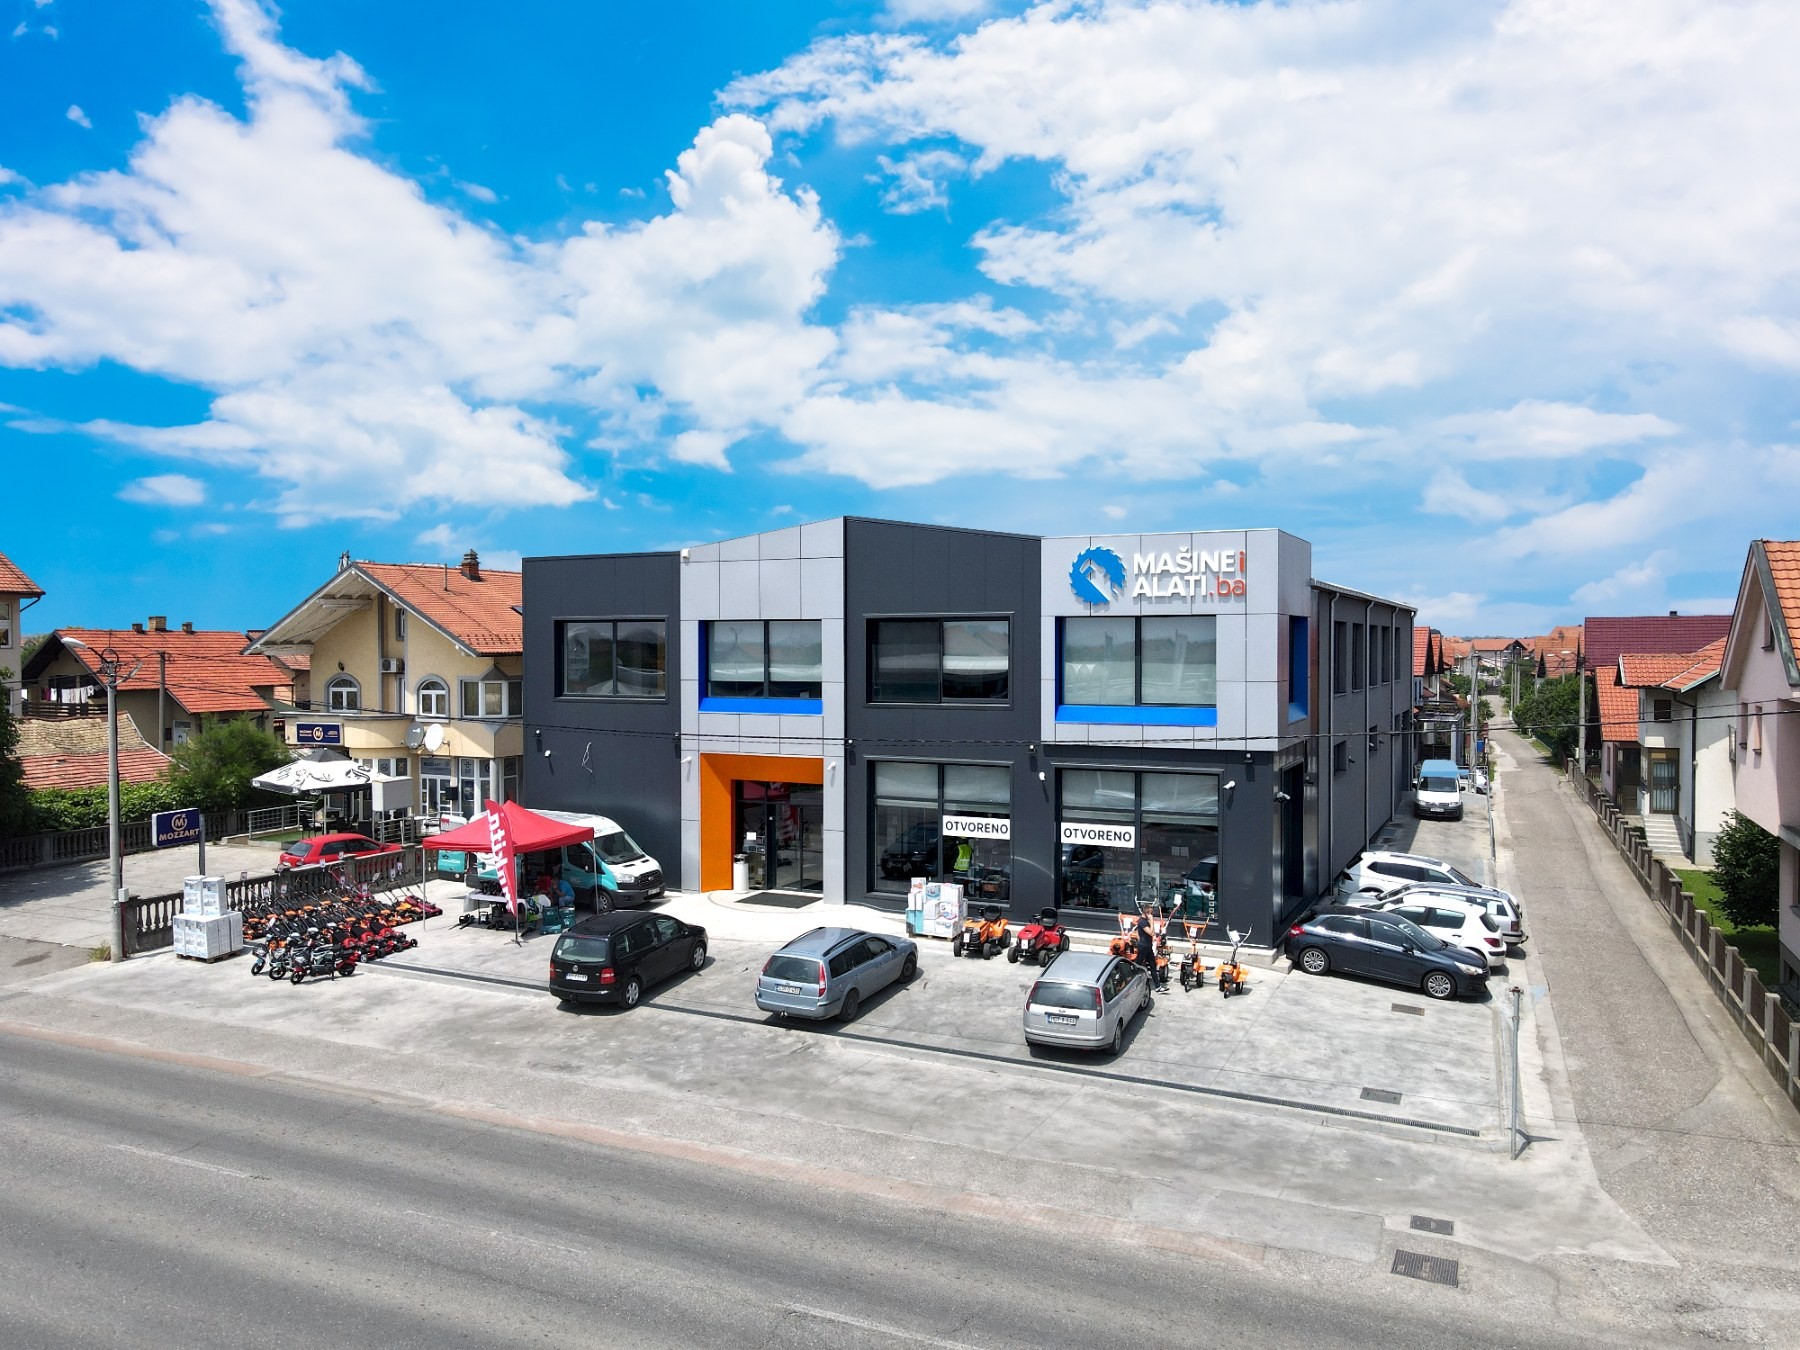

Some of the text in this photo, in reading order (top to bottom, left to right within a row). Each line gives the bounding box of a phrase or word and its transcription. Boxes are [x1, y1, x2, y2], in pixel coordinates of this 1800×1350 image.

[1133, 547, 1235, 574] MAŠINE
[945, 821, 1009, 834] OTVORENO
[159, 829, 199, 841] MOZZART
[1064, 828, 1132, 842] OTVORENO
